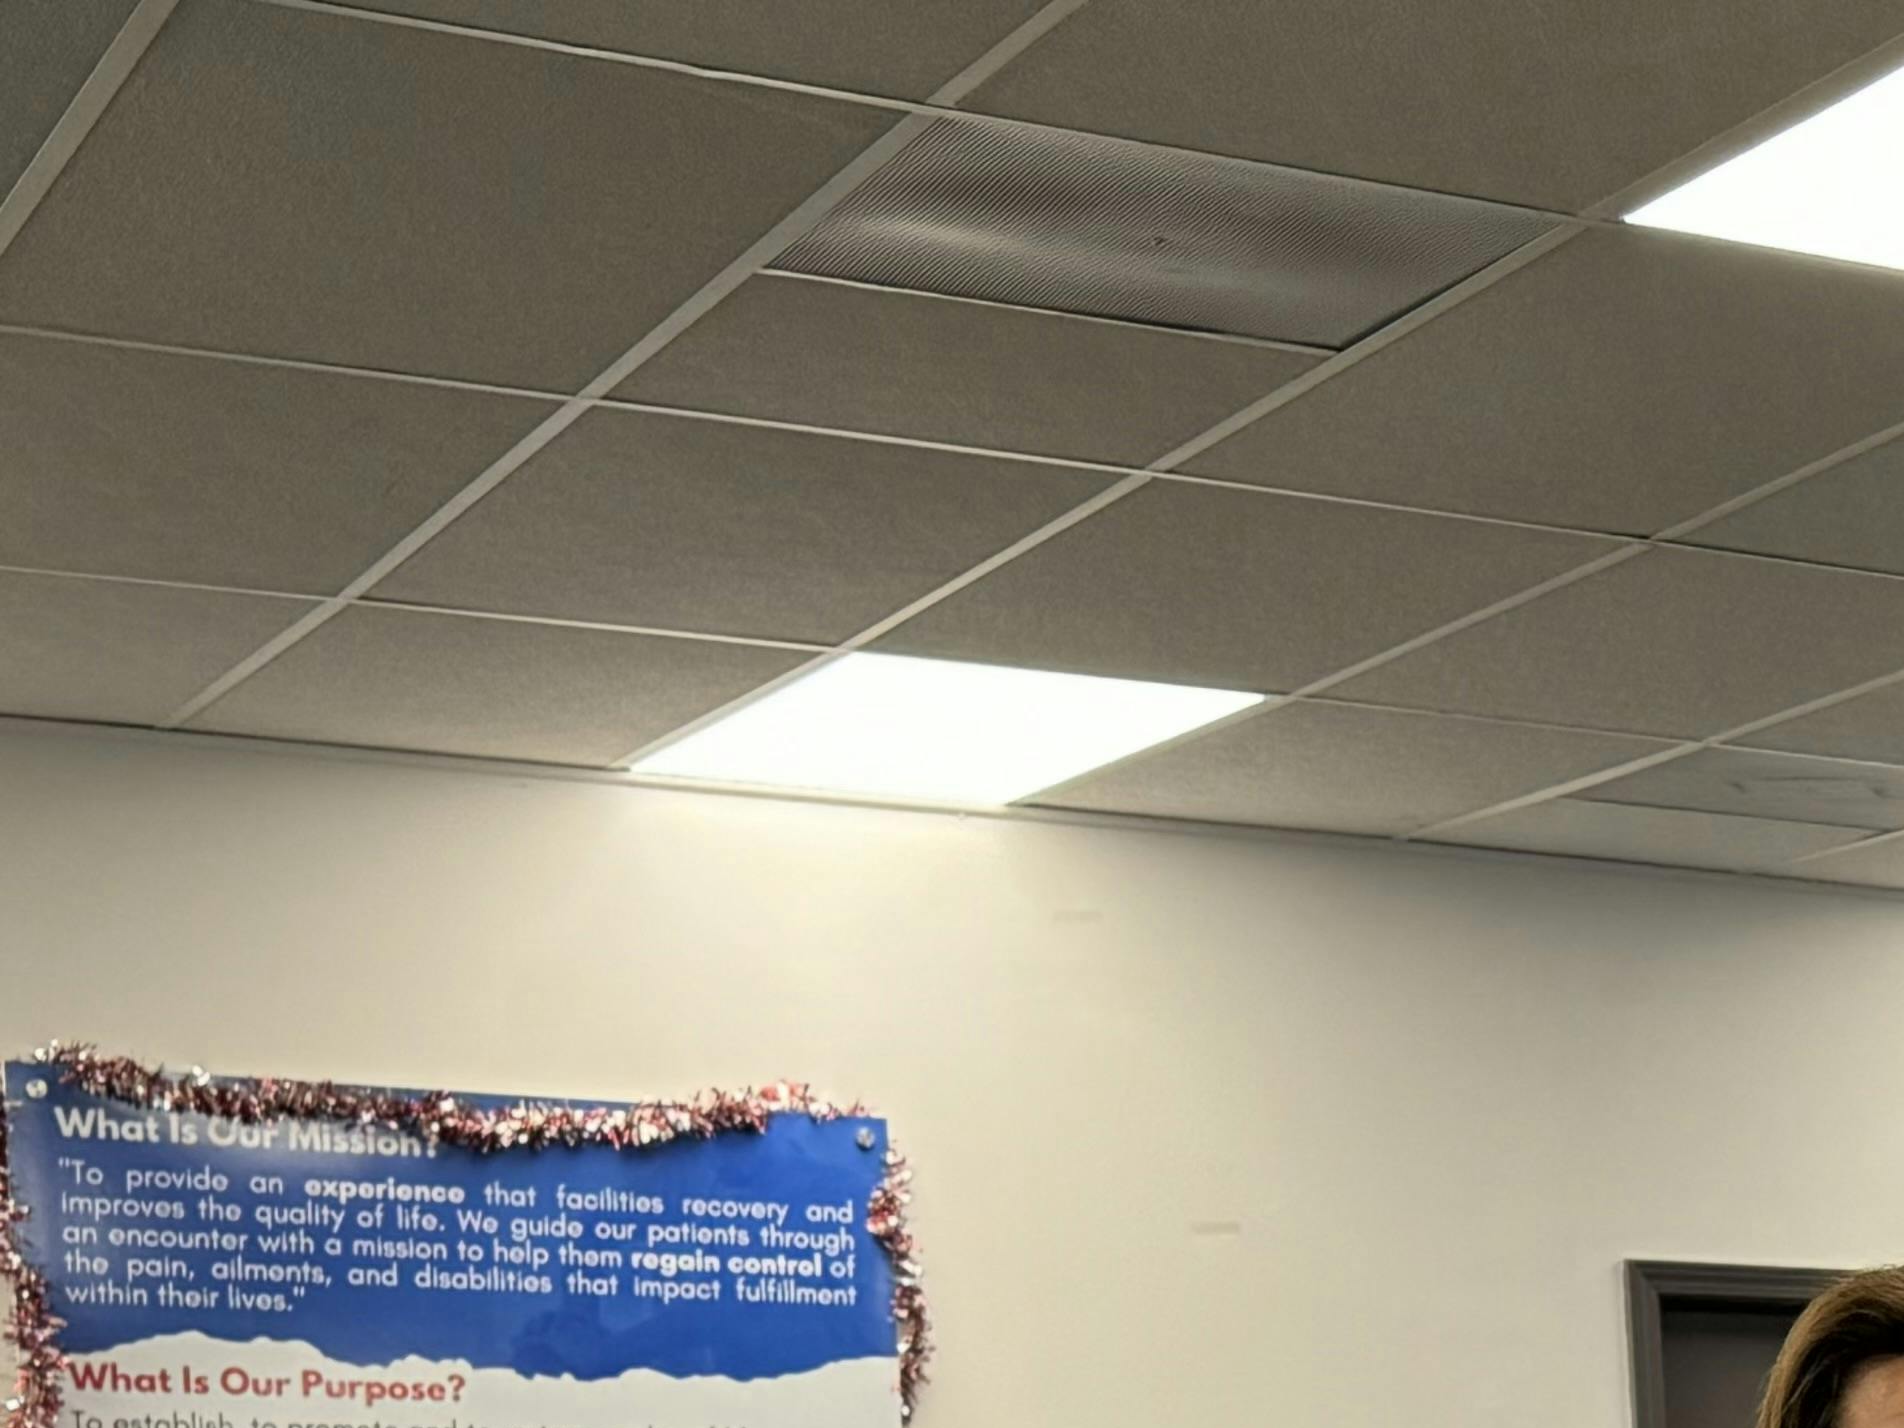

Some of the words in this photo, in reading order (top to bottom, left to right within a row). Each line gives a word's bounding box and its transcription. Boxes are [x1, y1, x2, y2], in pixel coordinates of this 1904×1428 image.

[55, 1107, 159, 1143] What
[171, 1116, 198, 1145] Is
[207, 1118, 277, 1149] Our
[58, 1157, 103, 1186] "To
[126, 1165, 228, 1193] provide
[249, 1174, 283, 1195] an
[304, 1177, 465, 1205] experience
[485, 1182, 535, 1207] that
[557, 1184, 664, 1214] facilities
[682, 1197, 789, 1225] recovery
[805, 1200, 853, 1224] and
[61, 1193, 184, 1220] improves
[197, 1197, 241, 1222] the
[255, 1203, 345, 1233] quality
[357, 1204, 384, 1228] of
[397, 1207, 445, 1232] life.
[457, 1209, 498, 1234] We
[511, 1215, 583, 1242] guide
[594, 1224, 636, 1240] our
[648, 1223, 750, 1248] patients
[760, 1226, 854, 1256] through
[62, 1225, 97, 1245] an
[109, 1227, 248, 1251] encounter
[258, 1231, 314, 1255] with
[325, 1237, 342, 1256] a
[352, 1237, 447, 1259] mission
[457, 1241, 483, 1261] to
[496, 1242, 549, 1266] help
[559, 1244, 622, 1267] them
[631, 1250, 720, 1276] regain
[728, 1254, 822, 1277] control
[830, 1256, 856, 1279] of
[65, 1250, 108, 1275] the
[127, 1257, 194, 1280] pain,
[211, 1256, 332, 1287] ailments,
[347, 1264, 398, 1287] and
[414, 1264, 552, 1293] disabilities
[567, 1273, 618, 1295] that
[634, 1276, 721, 1304] impact
[736, 1279, 857, 1306] fulfillment
[65, 1283, 148, 1307] within
[158, 1285, 219, 1309] their
[66, 1361, 171, 1393] What
[183, 1366, 209, 1395] Is
[220, 1367, 291, 1397] Our
[301, 1370, 466, 1407] Purpose?
